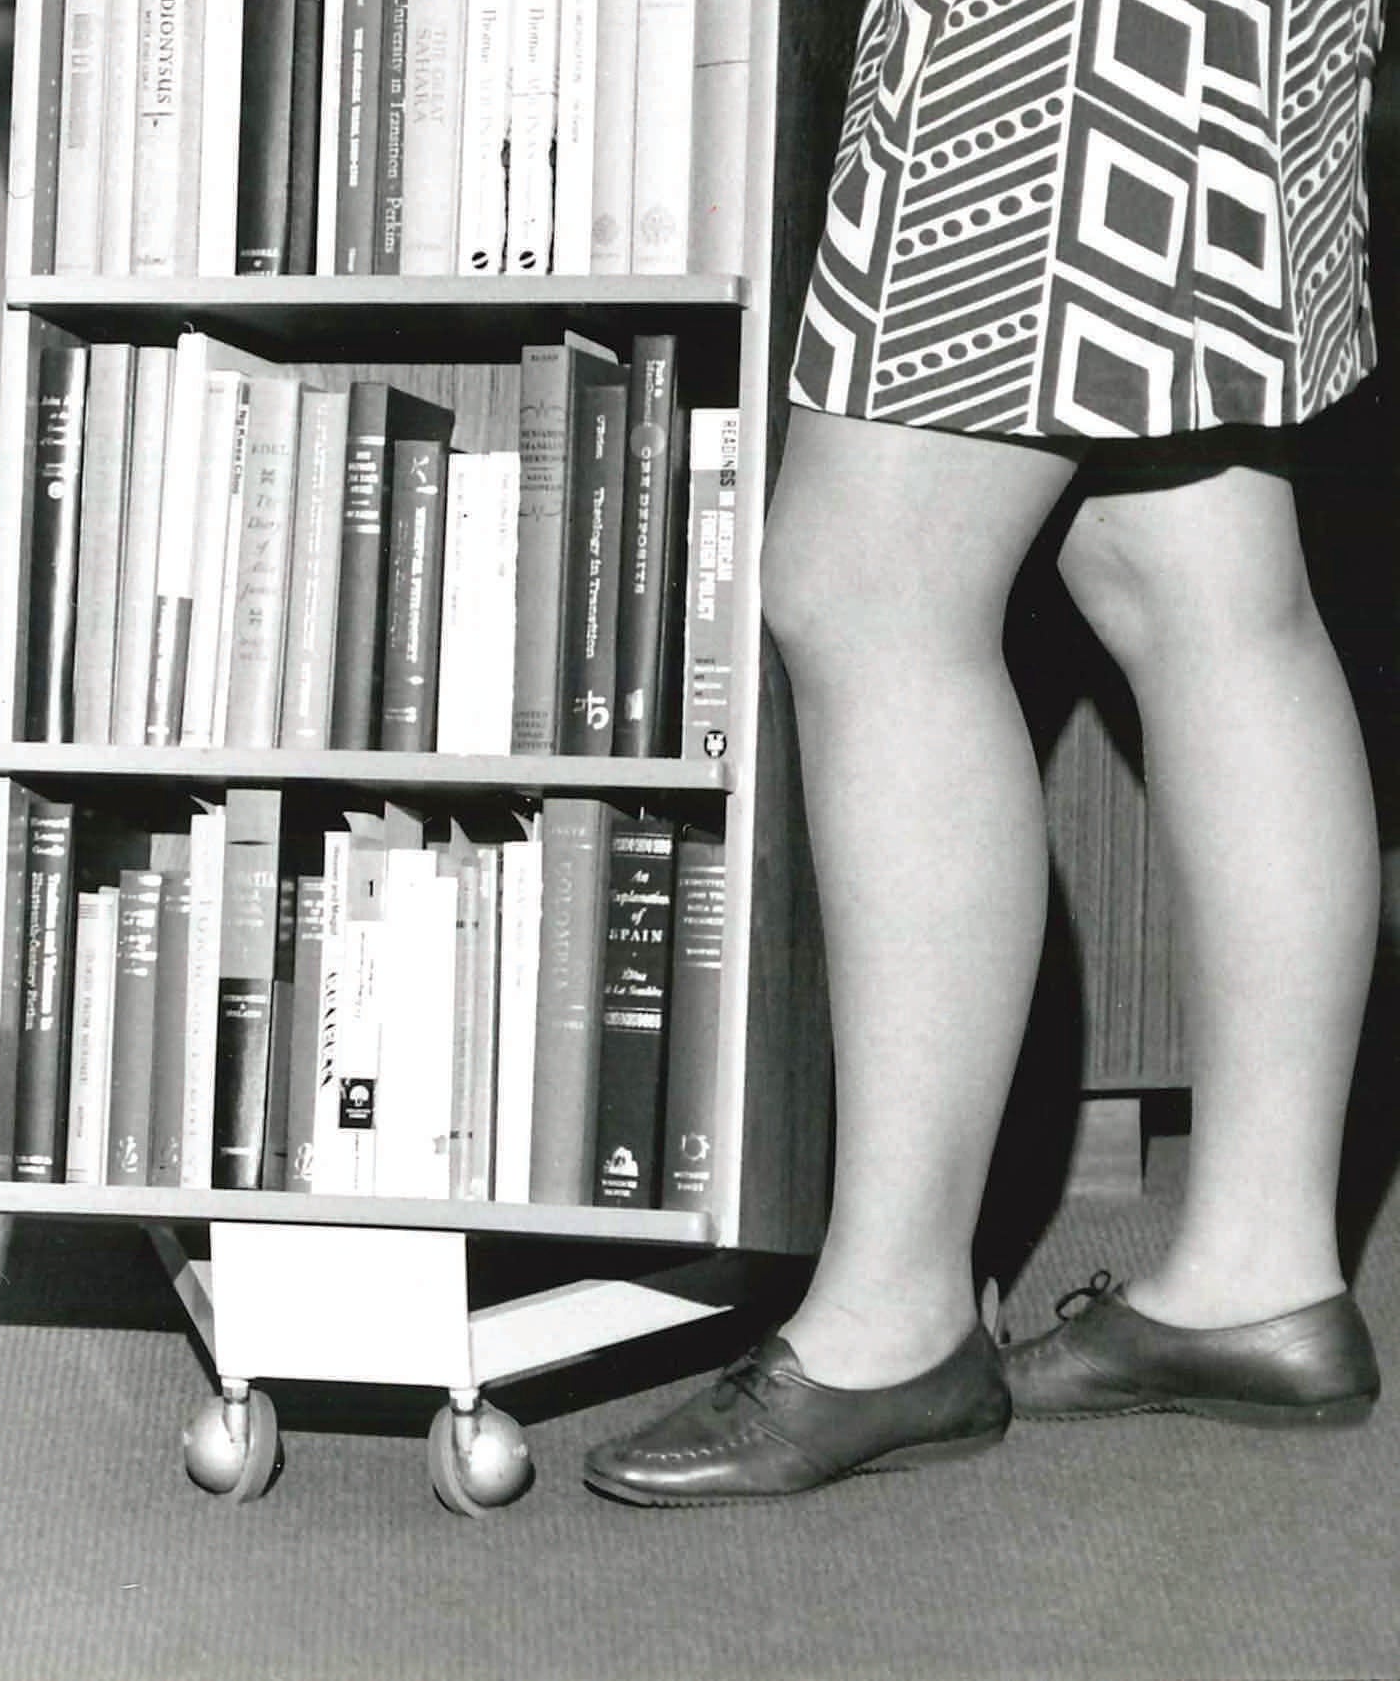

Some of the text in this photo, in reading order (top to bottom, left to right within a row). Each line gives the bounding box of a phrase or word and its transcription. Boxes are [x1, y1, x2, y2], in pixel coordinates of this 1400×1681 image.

[480, 8, 496, 64] Thomas
[527, 7, 544, 64] Thomas
[390, 78, 406, 93] in
[413, 28, 431, 124] SAHARA
[427, 27, 447, 125] THE GREAT
[386, 101, 406, 178] Transition
[383, 196, 400, 254] Perkins
[235, 409, 247, 427] Ng
[719, 420, 736, 486] READINGS
[633, 446, 652, 595] ORE DEPOSITS
[584, 486, 605, 659] Theology in Transition
[696, 571, 715, 622] POLICY
[613, 890, 670, 906] xplanation
[631, 907, 647, 926] of
[609, 929, 663, 943] SPAIN
[25, 990, 38, 1031] Fiction
